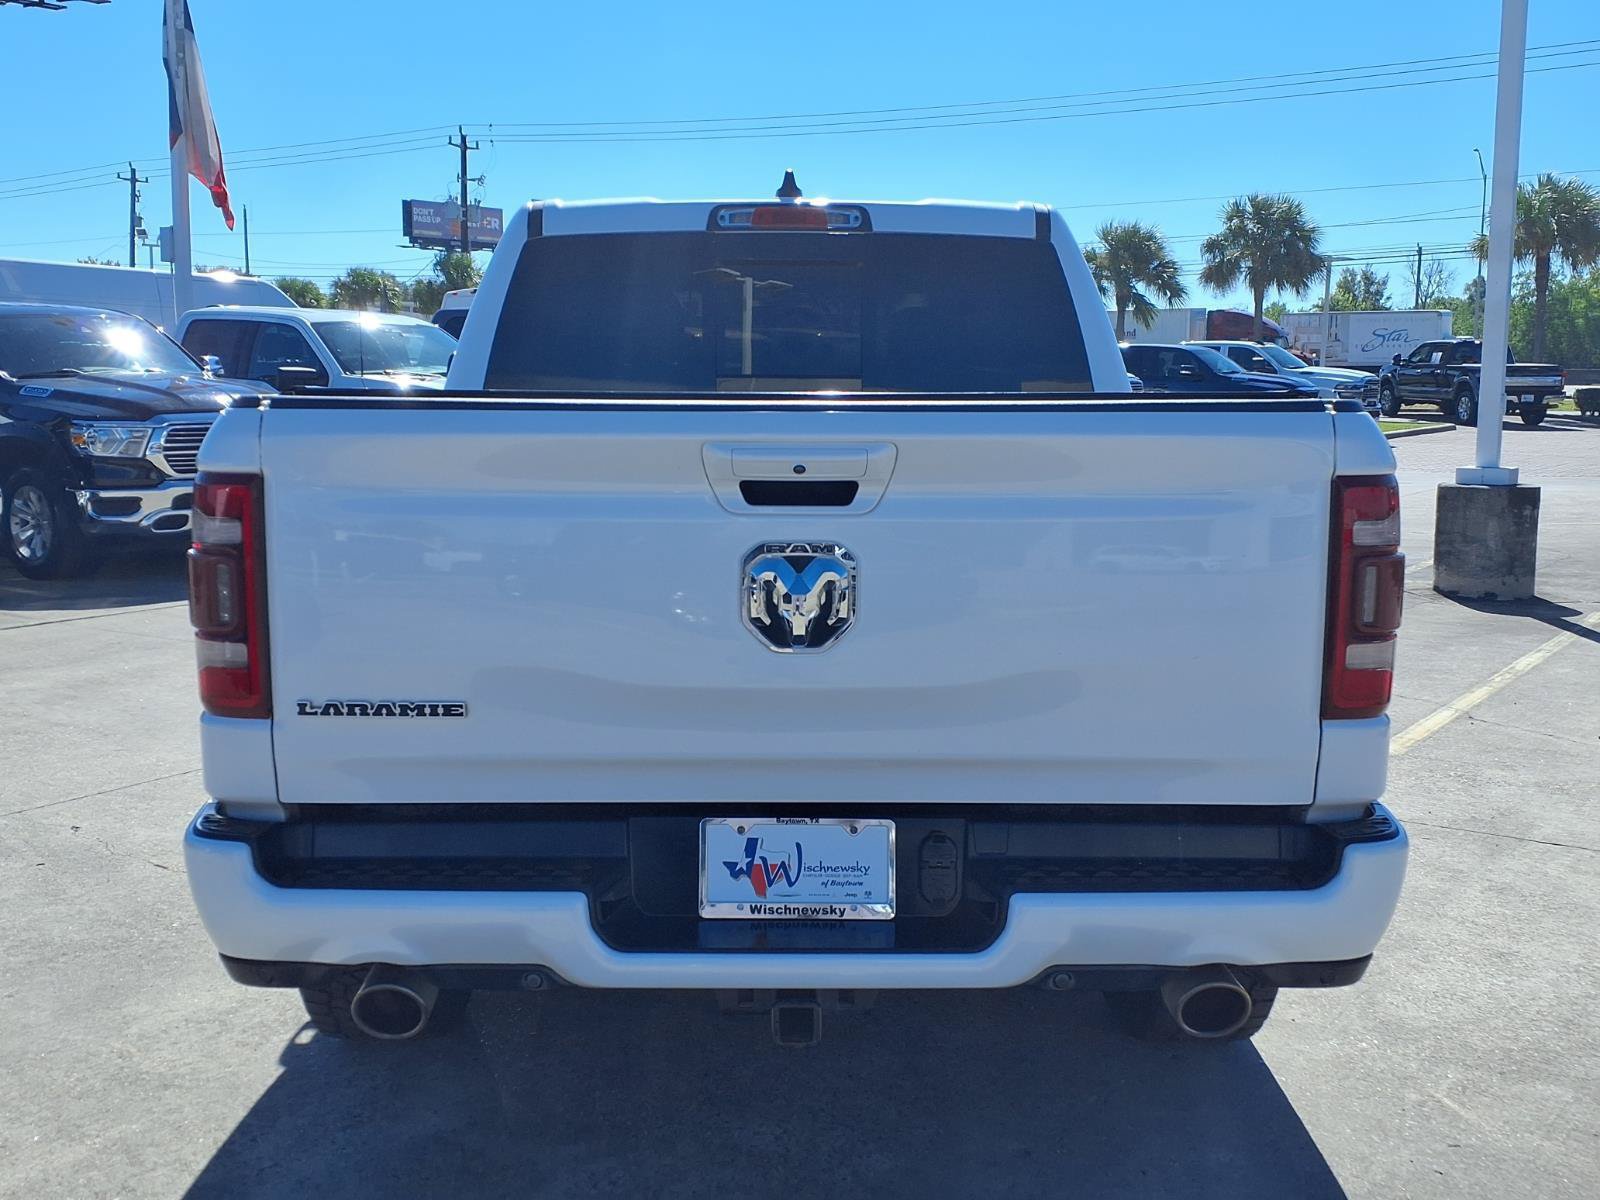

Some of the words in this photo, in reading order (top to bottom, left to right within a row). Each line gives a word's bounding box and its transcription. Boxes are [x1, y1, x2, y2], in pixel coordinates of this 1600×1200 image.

[413, 215, 431, 223] PASS
[431, 216, 441, 224] UP
[1361, 328, 1420, 352] Star
[764, 543, 835, 554] RAM
[297, 701, 467, 718] LARAMIE
[821, 880, 829, 888] of
[830, 880, 864, 888] Baytown
[750, 904, 846, 917] Wischnewsky
